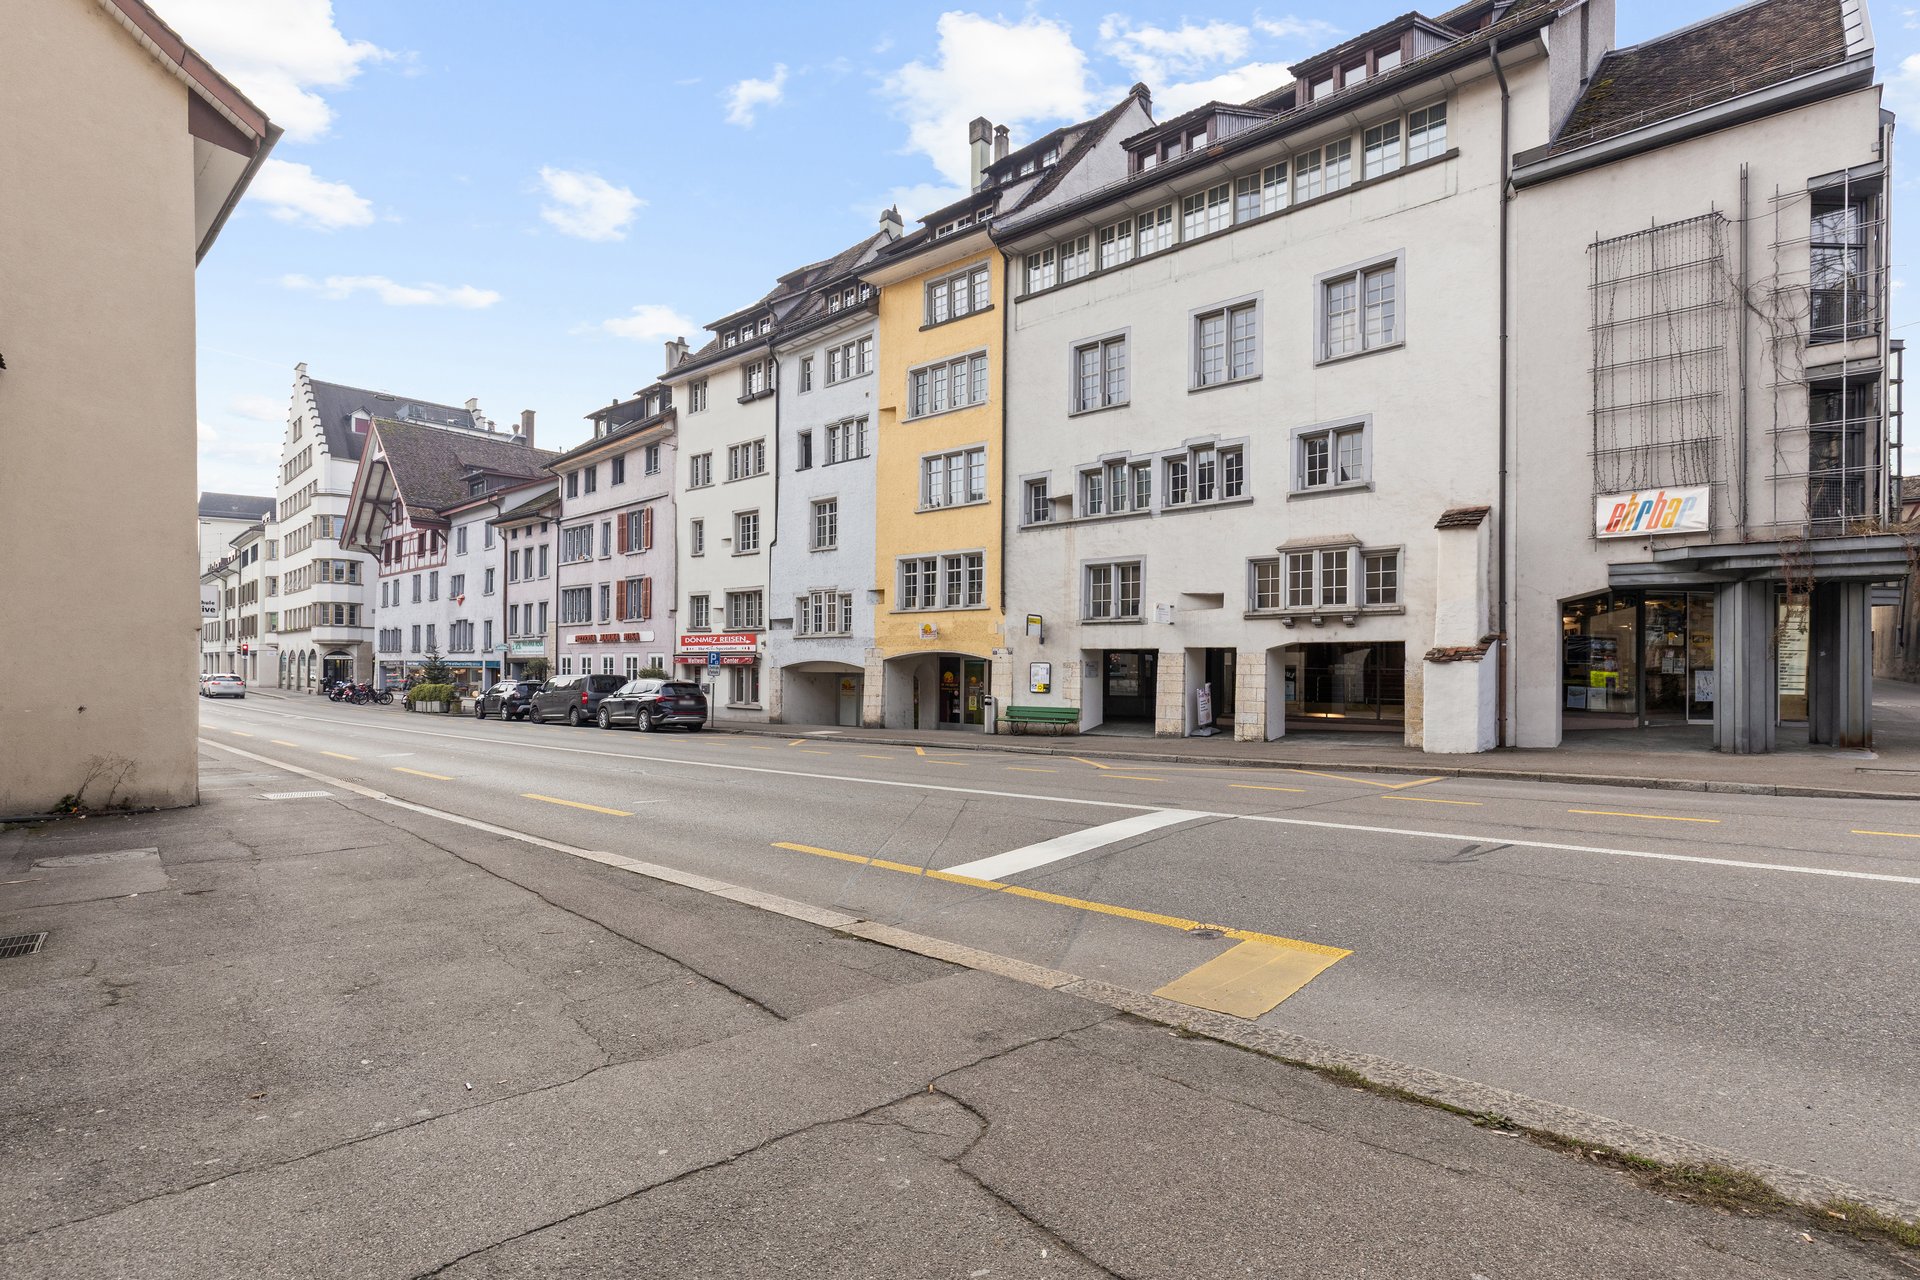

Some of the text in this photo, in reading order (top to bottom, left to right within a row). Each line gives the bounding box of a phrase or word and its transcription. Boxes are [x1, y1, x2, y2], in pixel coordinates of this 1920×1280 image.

[1605, 490, 1698, 533] ehrbar
[685, 635, 746, 644] DÖNMEZ REISEN
[710, 654, 716, 663] P
